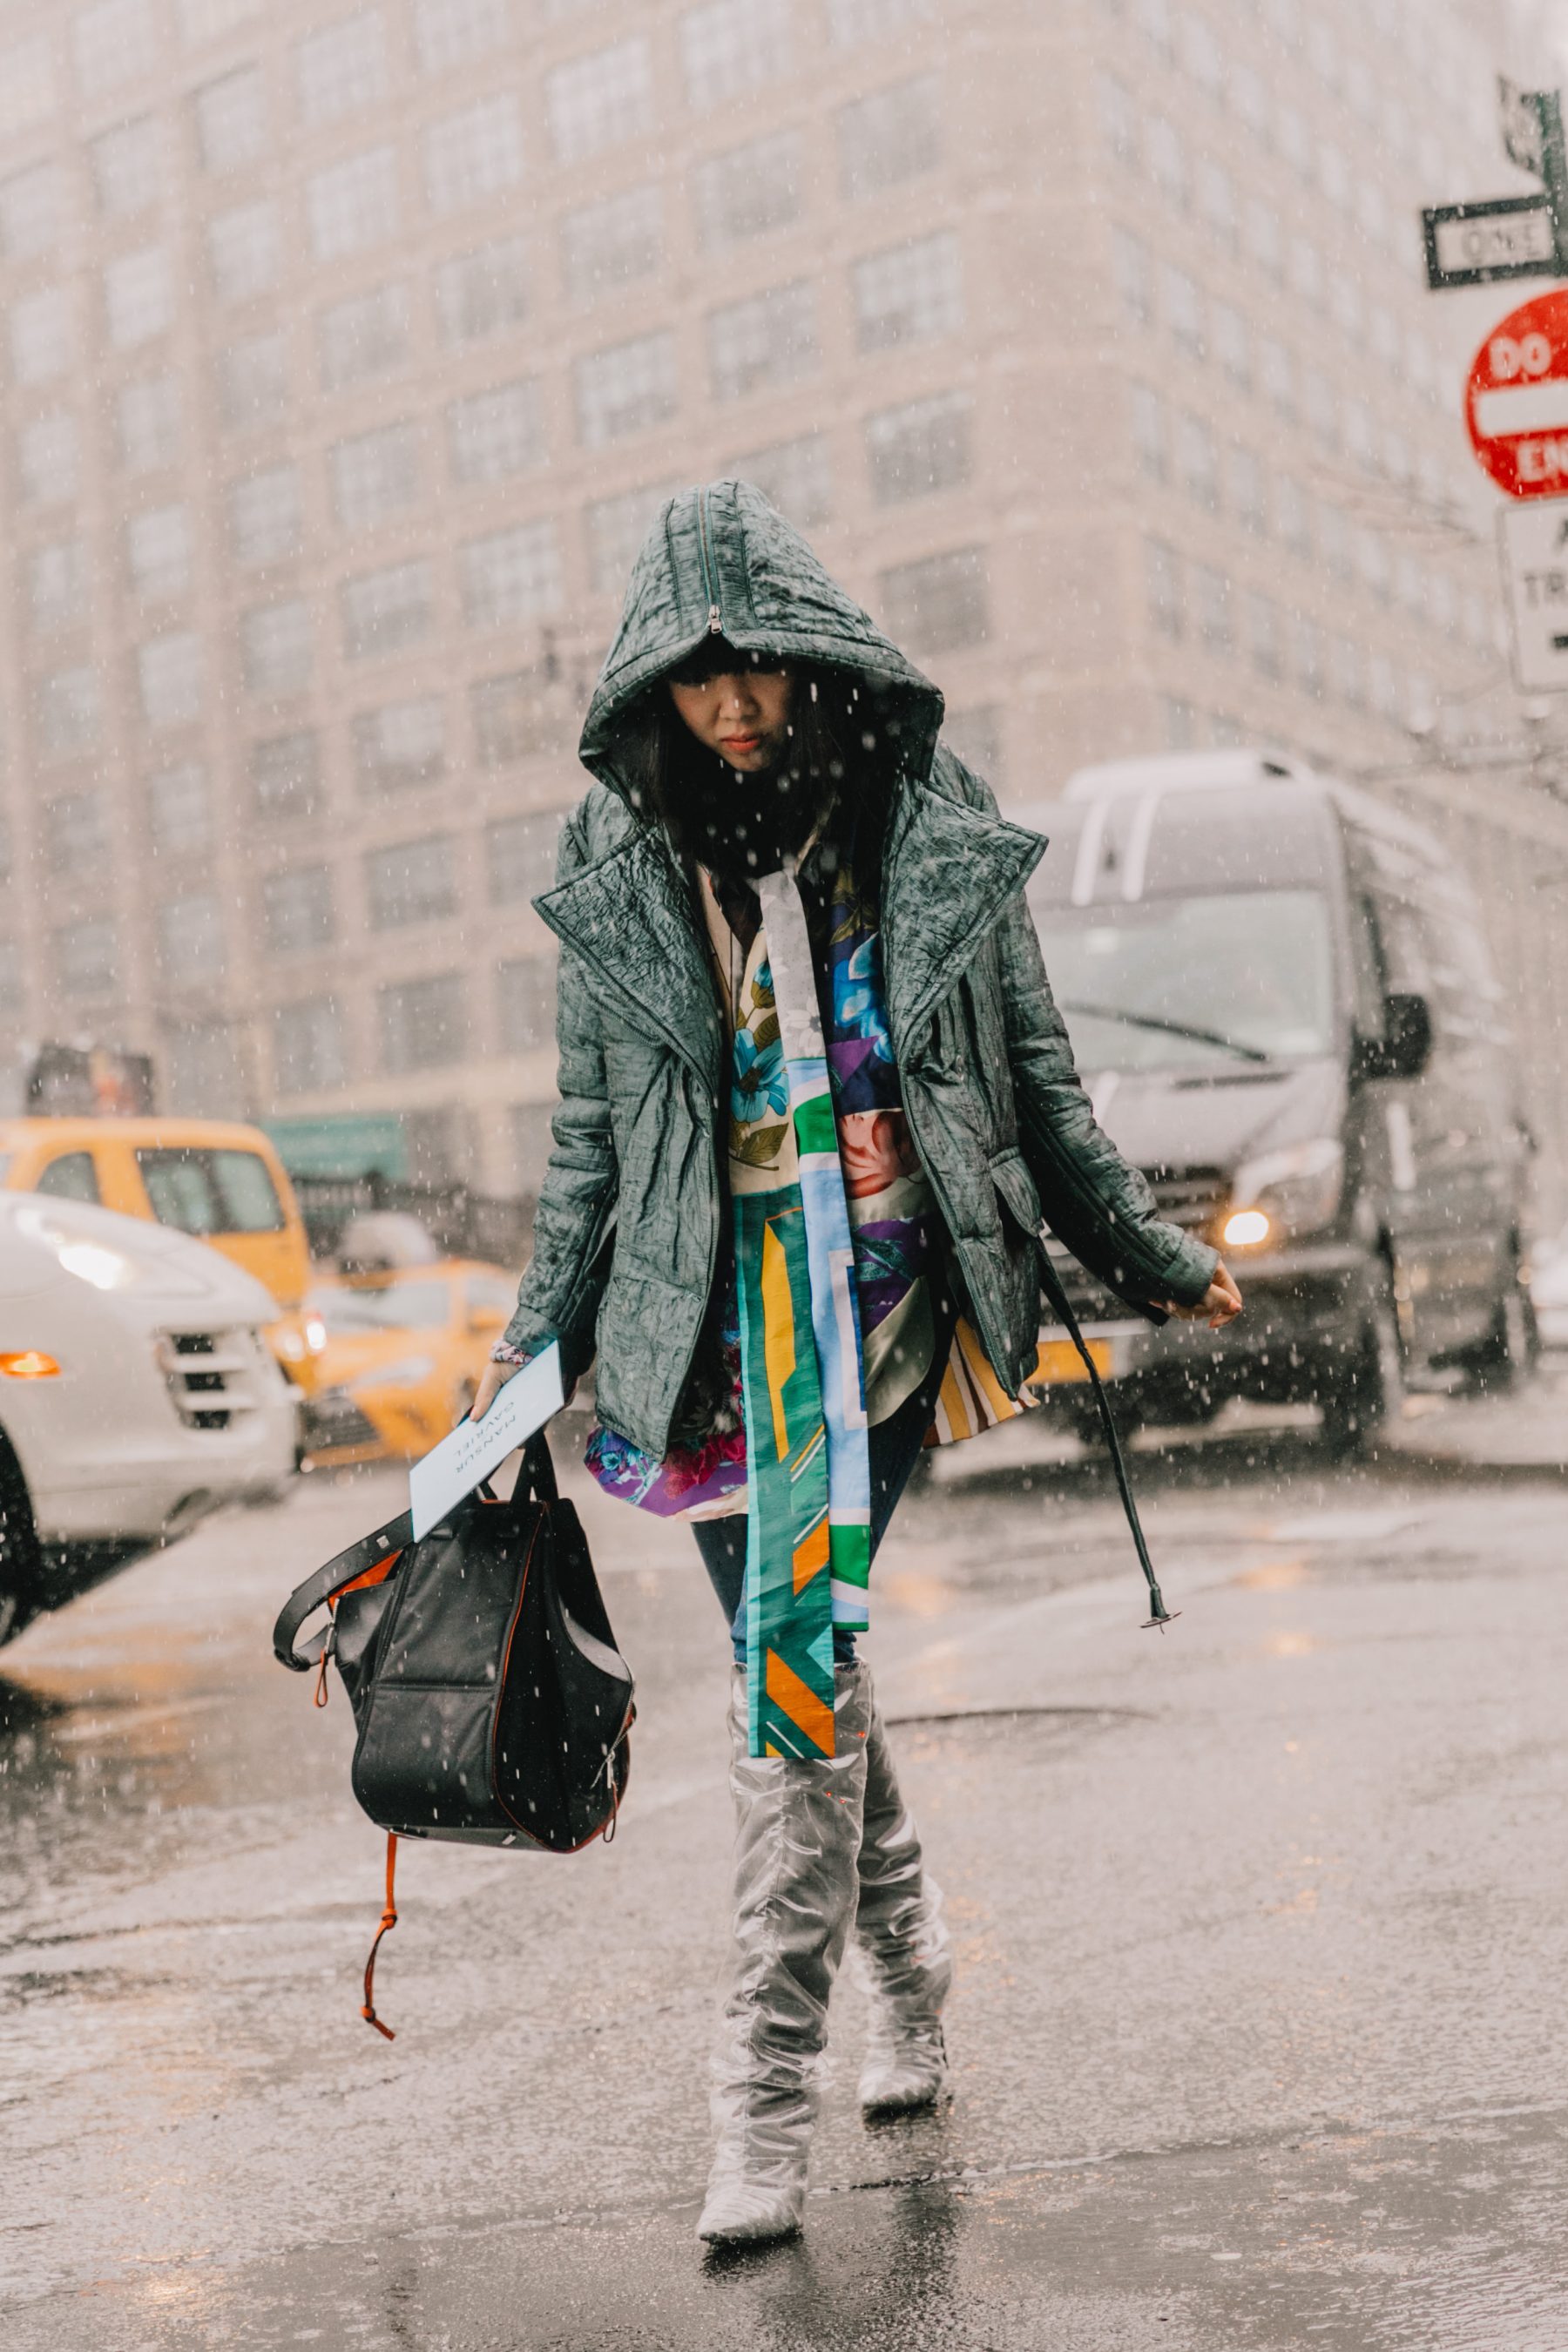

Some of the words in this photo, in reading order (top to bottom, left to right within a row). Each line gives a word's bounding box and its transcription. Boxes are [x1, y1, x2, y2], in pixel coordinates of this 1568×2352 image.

[1461, 223, 1542, 264] ONE
[1490, 333, 1552, 380] DO
[453, 1401, 515, 1456] GAVRIEL
[456, 1415, 516, 1473] MANSUR
